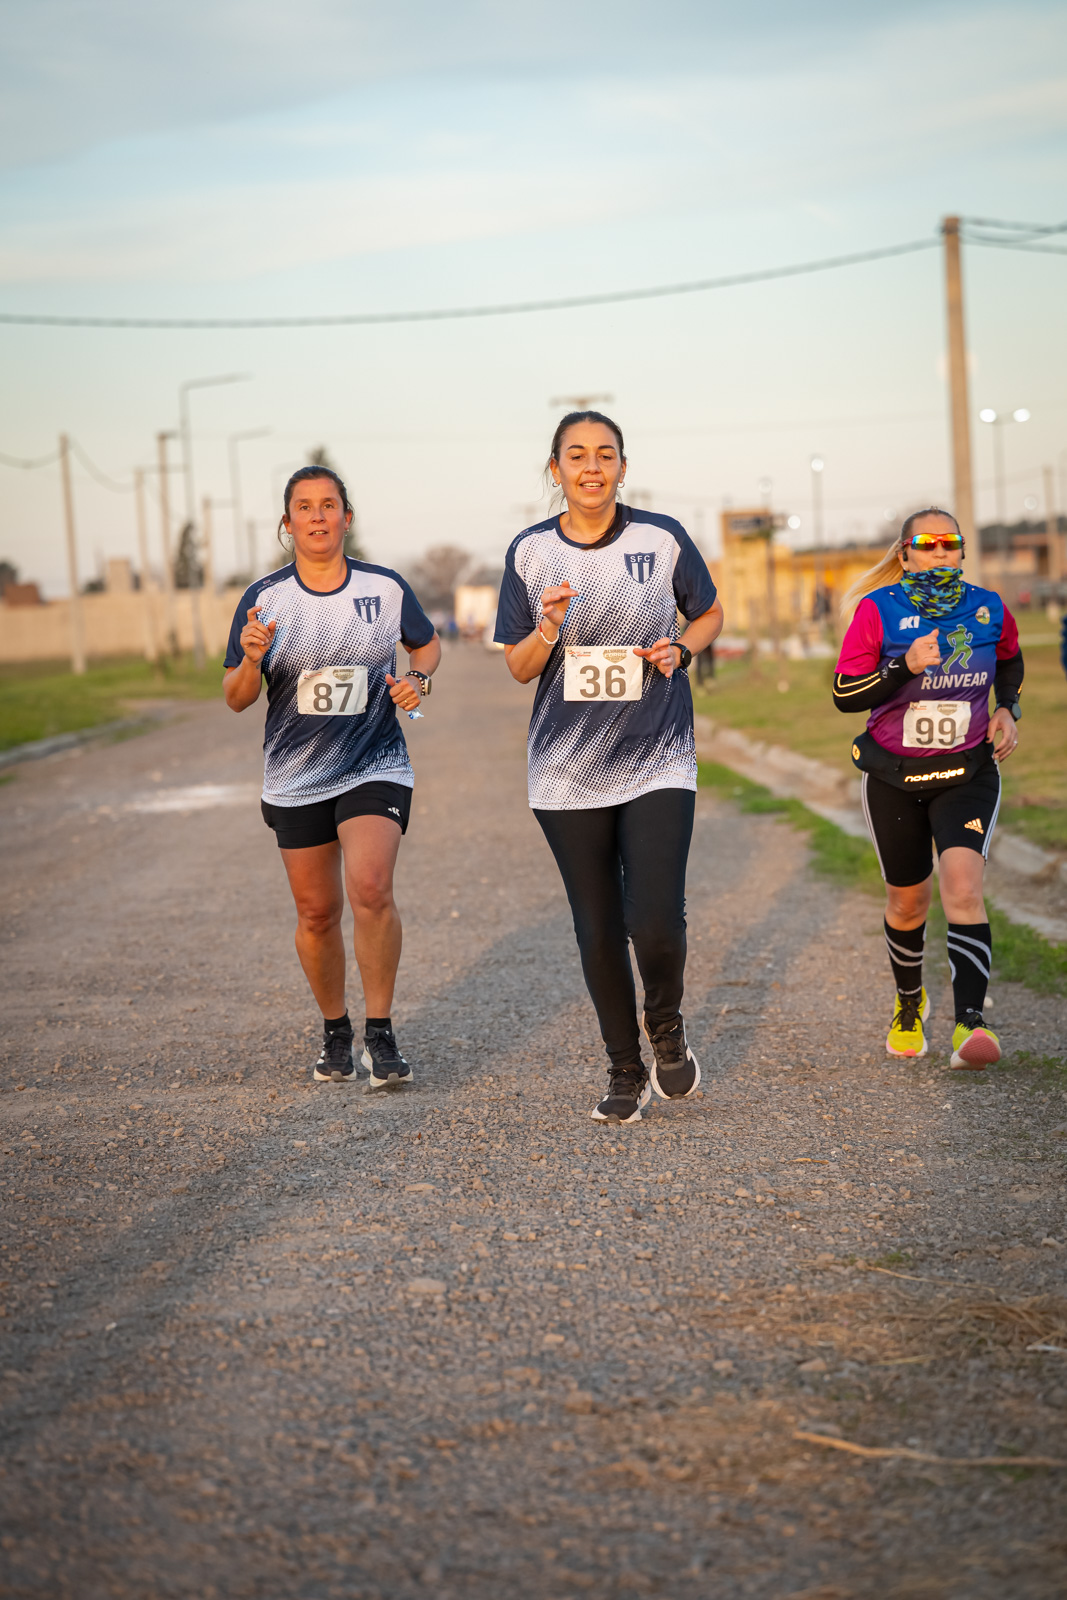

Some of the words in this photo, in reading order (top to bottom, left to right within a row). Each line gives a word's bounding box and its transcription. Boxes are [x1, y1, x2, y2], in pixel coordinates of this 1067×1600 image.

[630, 555, 650, 563] SFC
[358, 598, 376, 606] SFC
[579, 665, 627, 698] 36
[921, 671, 988, 690] RUNVEAR
[313, 682, 354, 713] 87
[915, 717, 957, 746] 99
